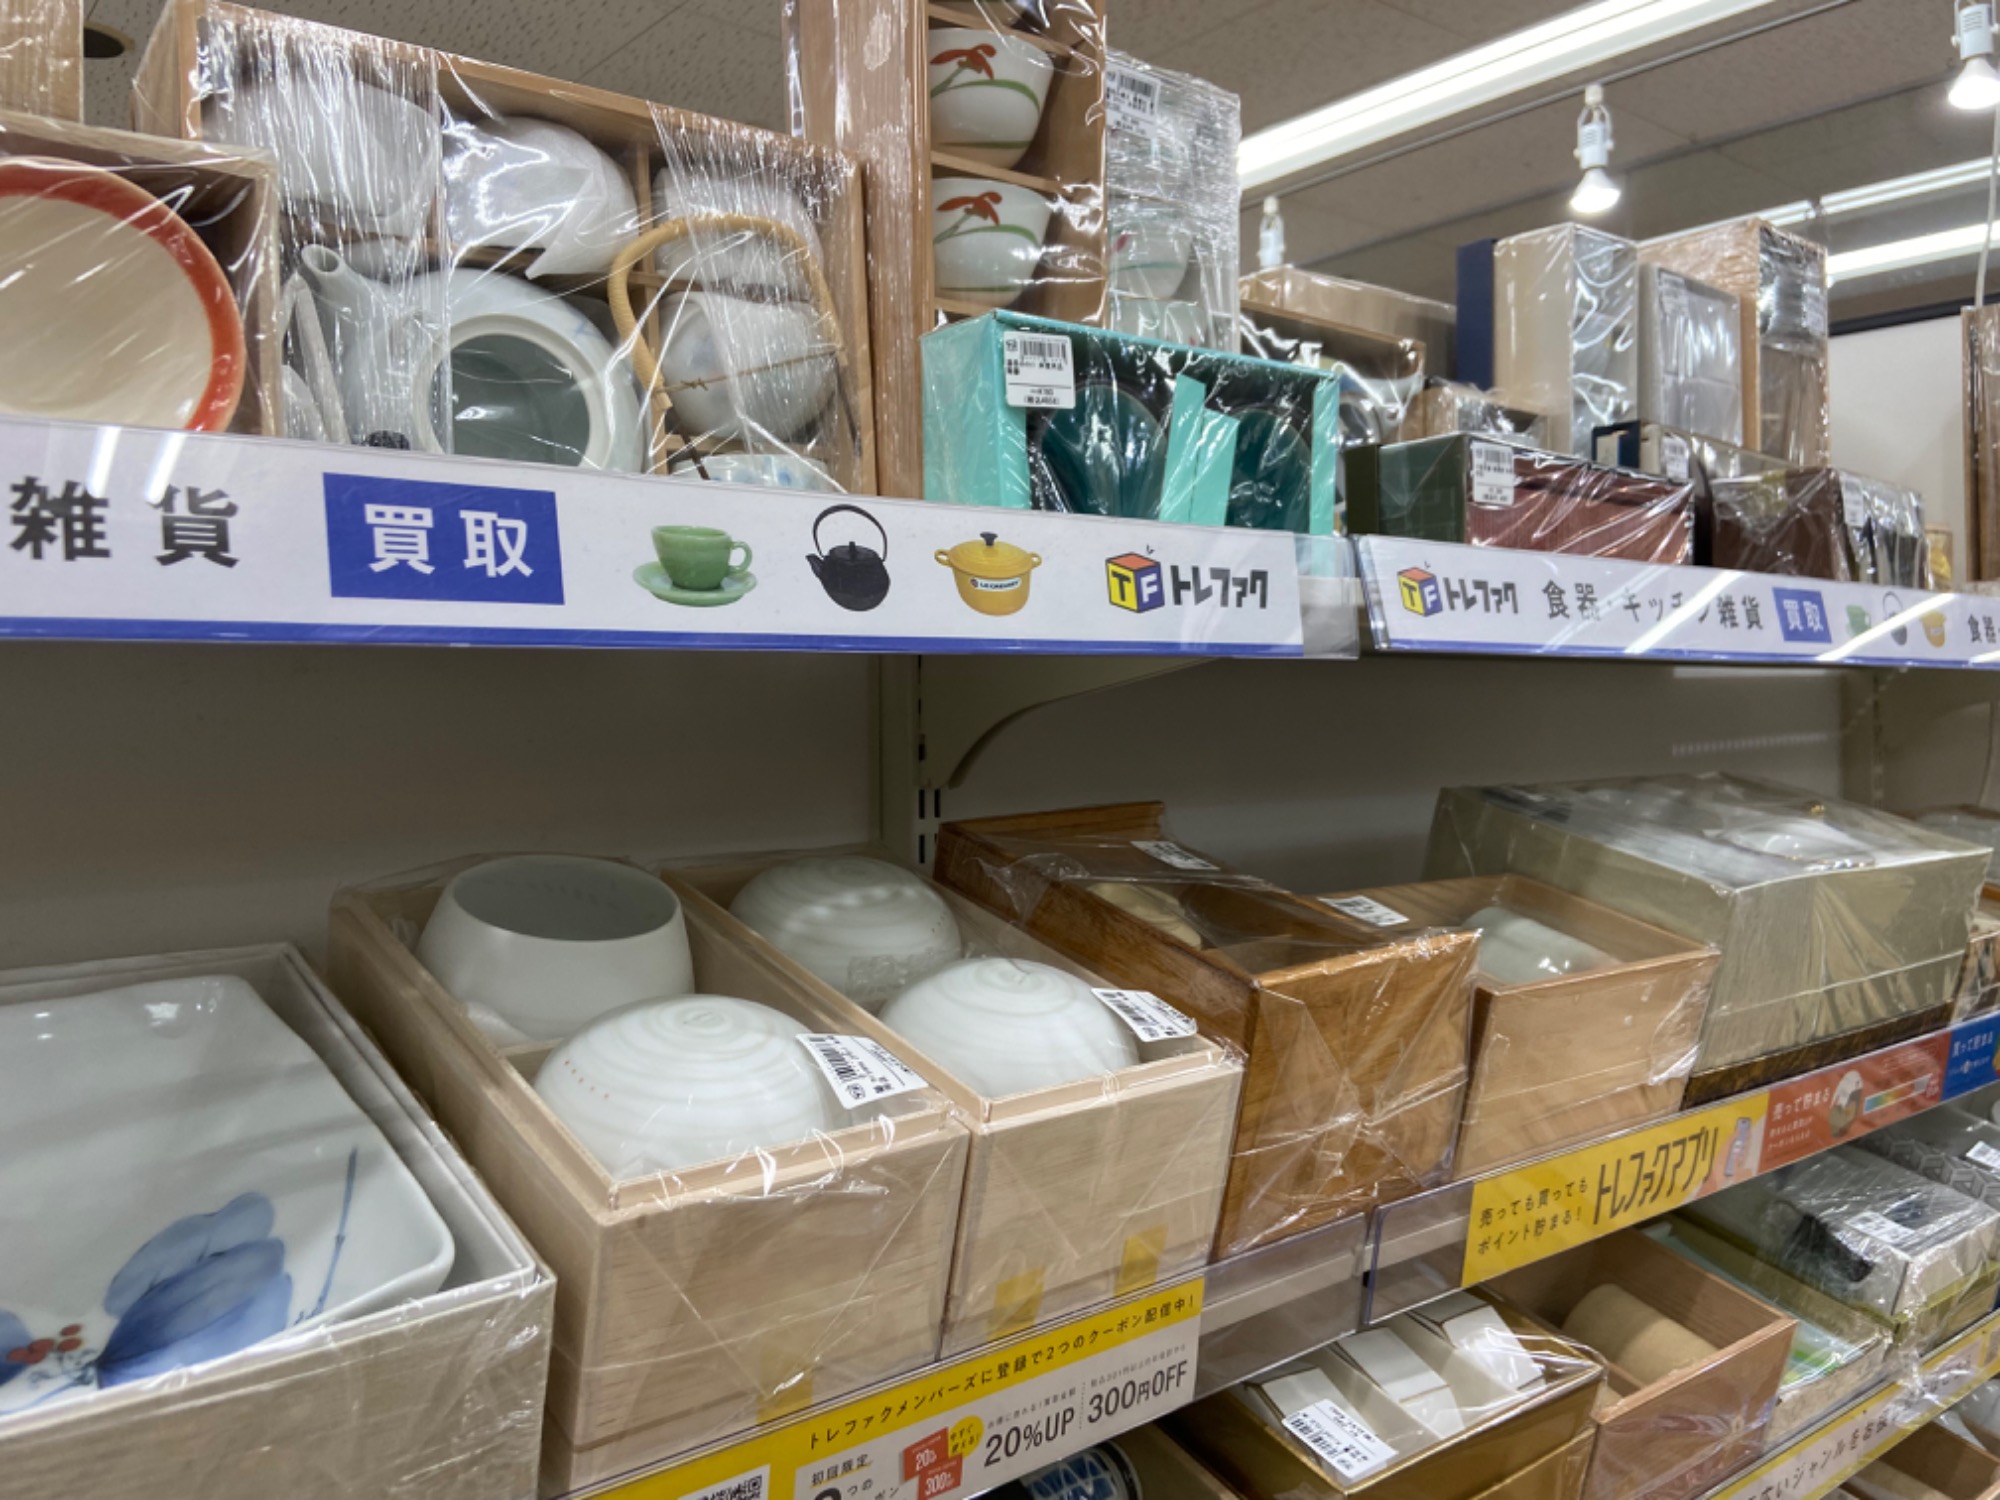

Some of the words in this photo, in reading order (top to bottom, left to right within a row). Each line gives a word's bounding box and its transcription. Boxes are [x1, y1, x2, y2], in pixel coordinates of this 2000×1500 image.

[364, 502, 534, 579] 買取
[1171, 562, 1268, 611] トレファク
[1444, 576, 1519, 615] トレファク
[1784, 598, 1825, 634] 買取
[1478, 1176, 1588, 1229] 売っても買っても
[1593, 1126, 1720, 1226] トレファクアプリ
[1086, 1359, 1189, 1424] 300円OFF
[983, 1406, 1075, 1469] 20%UP
[811, 1453, 869, 1487] 初回限定
